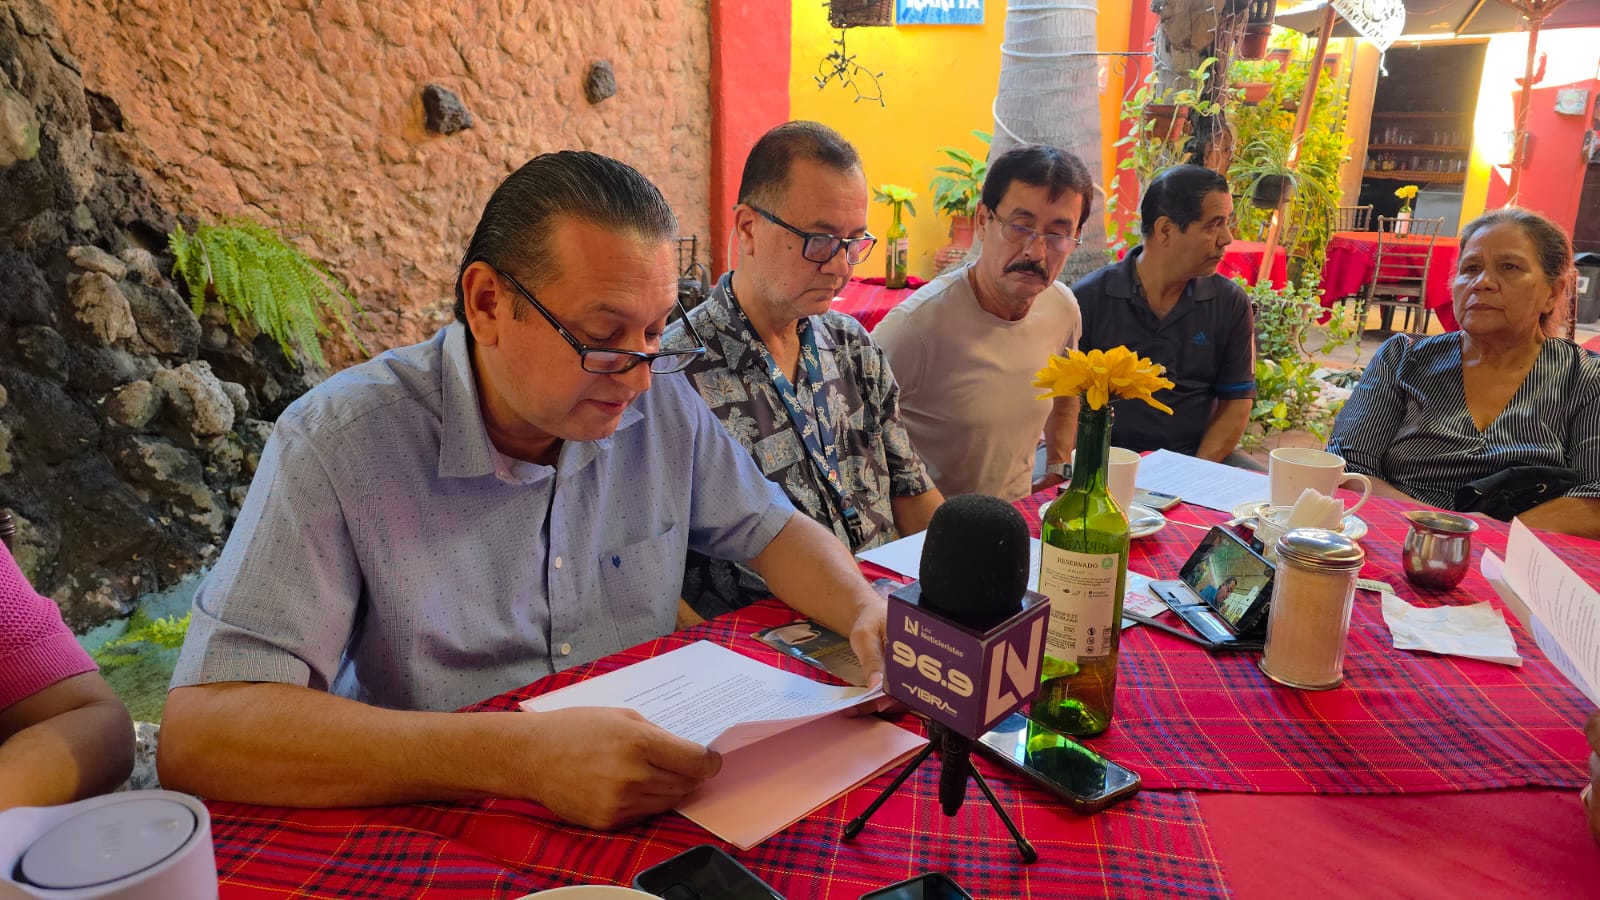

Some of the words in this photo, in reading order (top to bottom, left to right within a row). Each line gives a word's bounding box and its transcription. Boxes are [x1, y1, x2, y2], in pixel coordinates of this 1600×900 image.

[1057, 557, 1099, 569] RESERVADO
[921, 632, 964, 658] Noticieristas
[892, 640, 974, 697] 96.9
[902, 682, 958, 715] VIBRA
